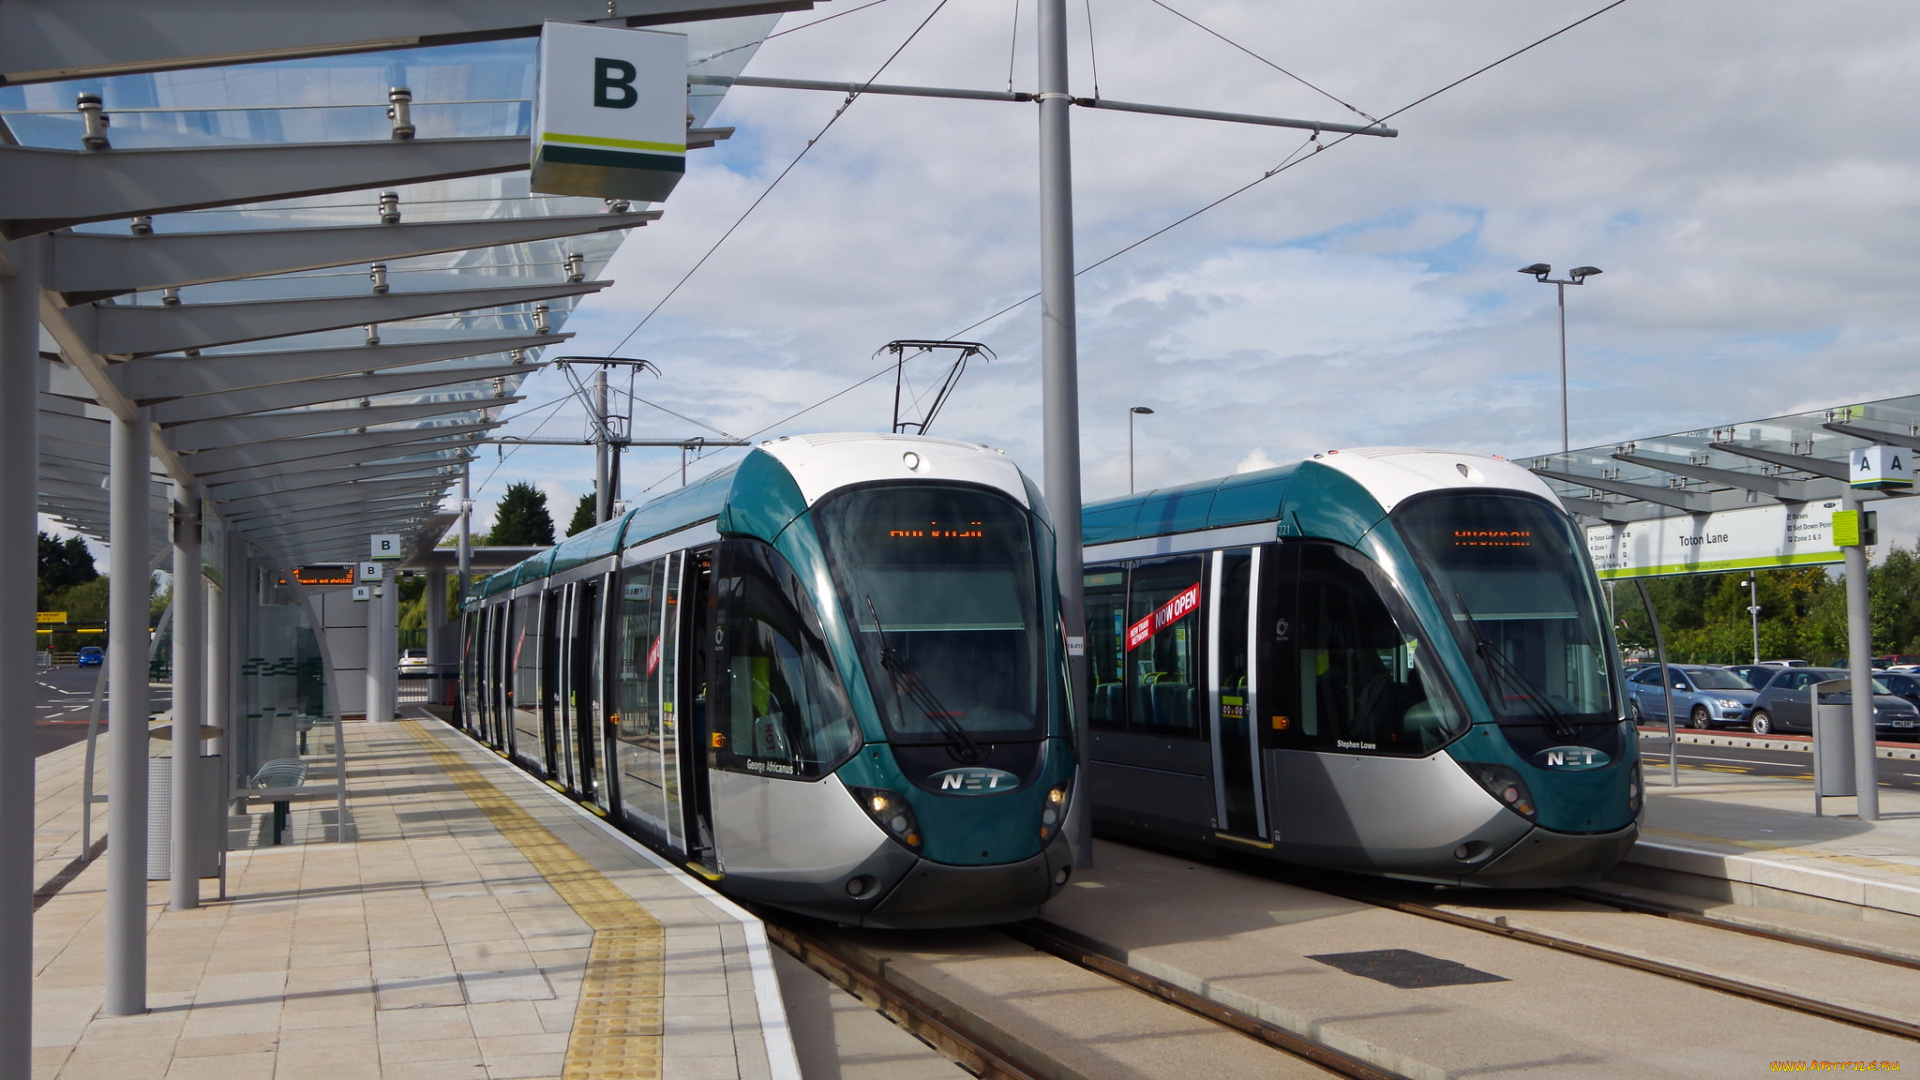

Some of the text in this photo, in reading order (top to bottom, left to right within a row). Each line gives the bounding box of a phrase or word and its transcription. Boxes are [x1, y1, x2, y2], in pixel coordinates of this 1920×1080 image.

[593, 57, 638, 109] B
[1860, 456, 1871, 471] A
[1891, 455, 1902, 470] A
[1278, 525, 1290, 535] 221
[381, 540, 390, 550] B
[1679, 533, 1729, 546] Toton Lane
[368, 567, 375, 575] B
[1155, 588, 1197, 629] NOW OPEN
[1130, 625, 1140, 638] NEW
[1337, 739, 1376, 750] Stephen Lowe
[1547, 751, 1596, 766] NET
[746, 758, 793, 775] George Africanus
[941, 773, 1004, 789] NET
